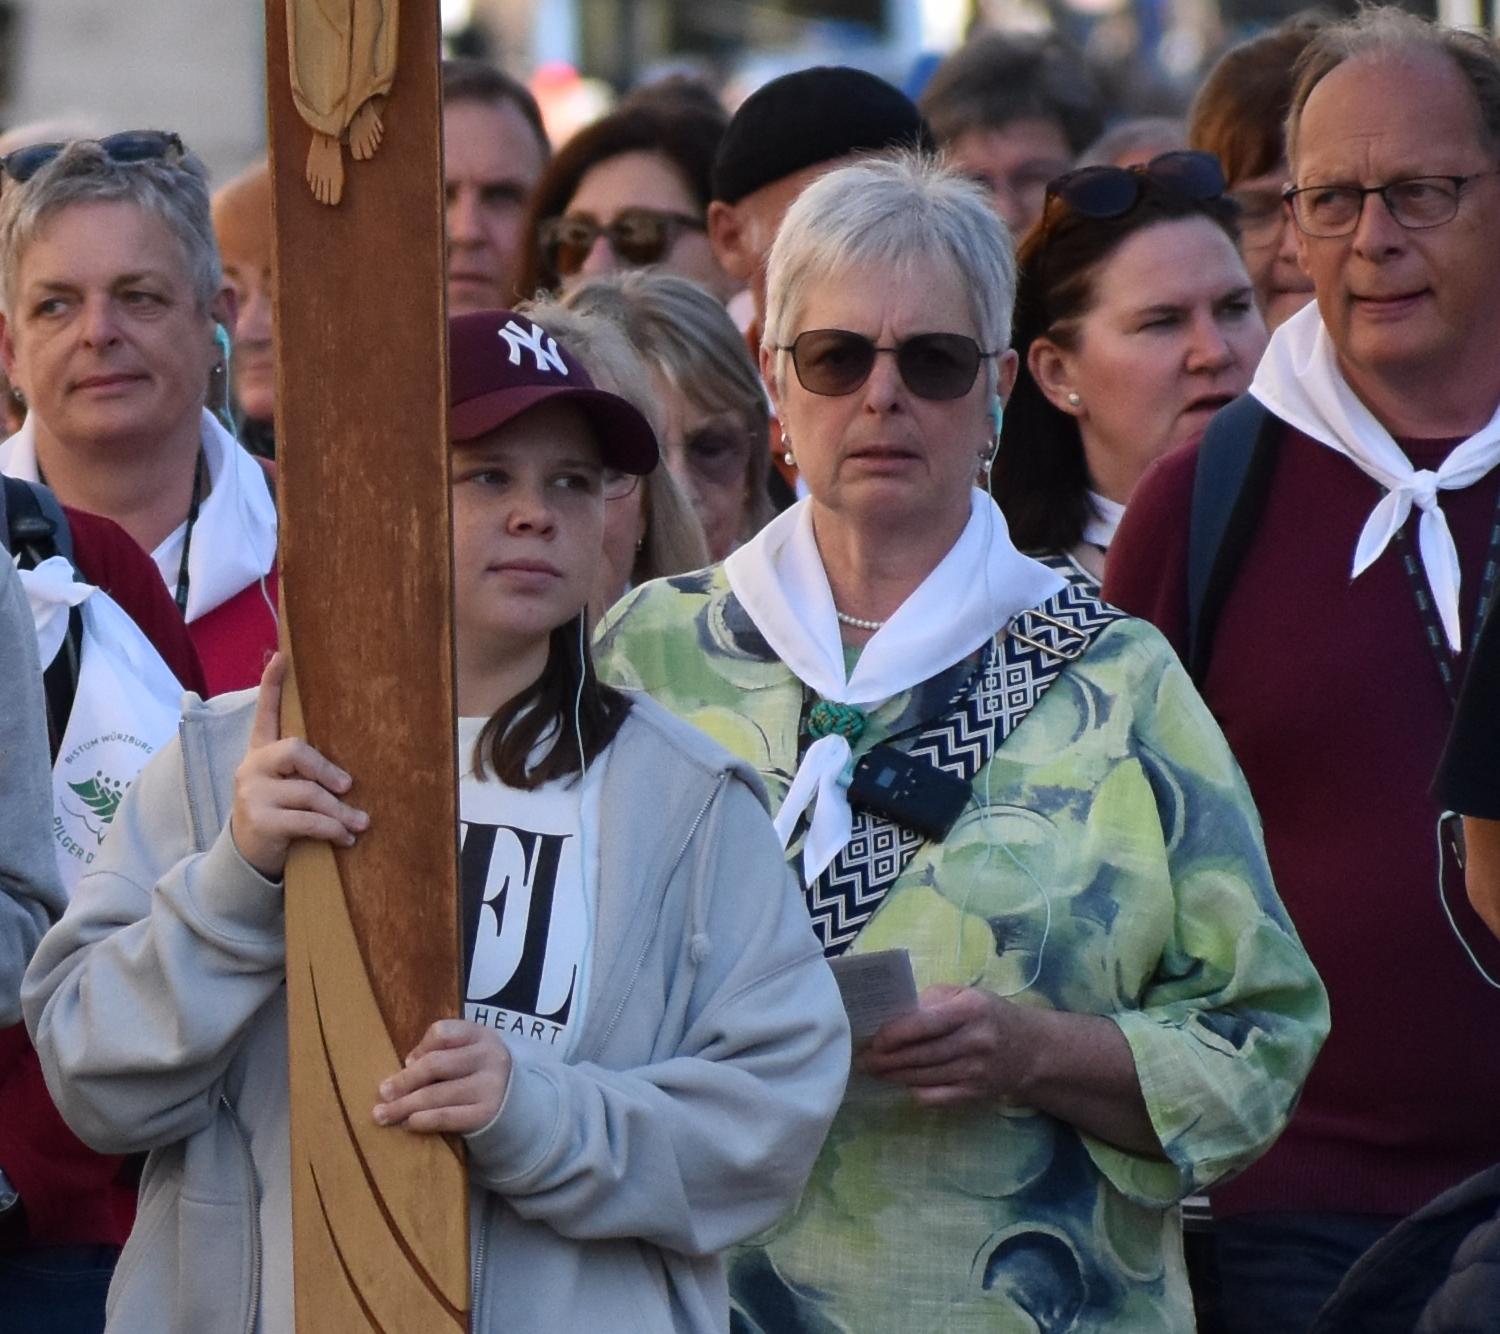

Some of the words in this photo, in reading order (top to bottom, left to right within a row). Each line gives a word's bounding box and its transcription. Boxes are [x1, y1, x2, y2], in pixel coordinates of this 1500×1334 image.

[498, 320, 569, 376] NY
[64, 738, 99, 765] BISTUM
[101, 732, 154, 755] WÜRZBURG
[53, 816, 85, 860] PILGER
[460, 819, 577, 1026] EL
[474, 1007, 564, 1046] HEART
